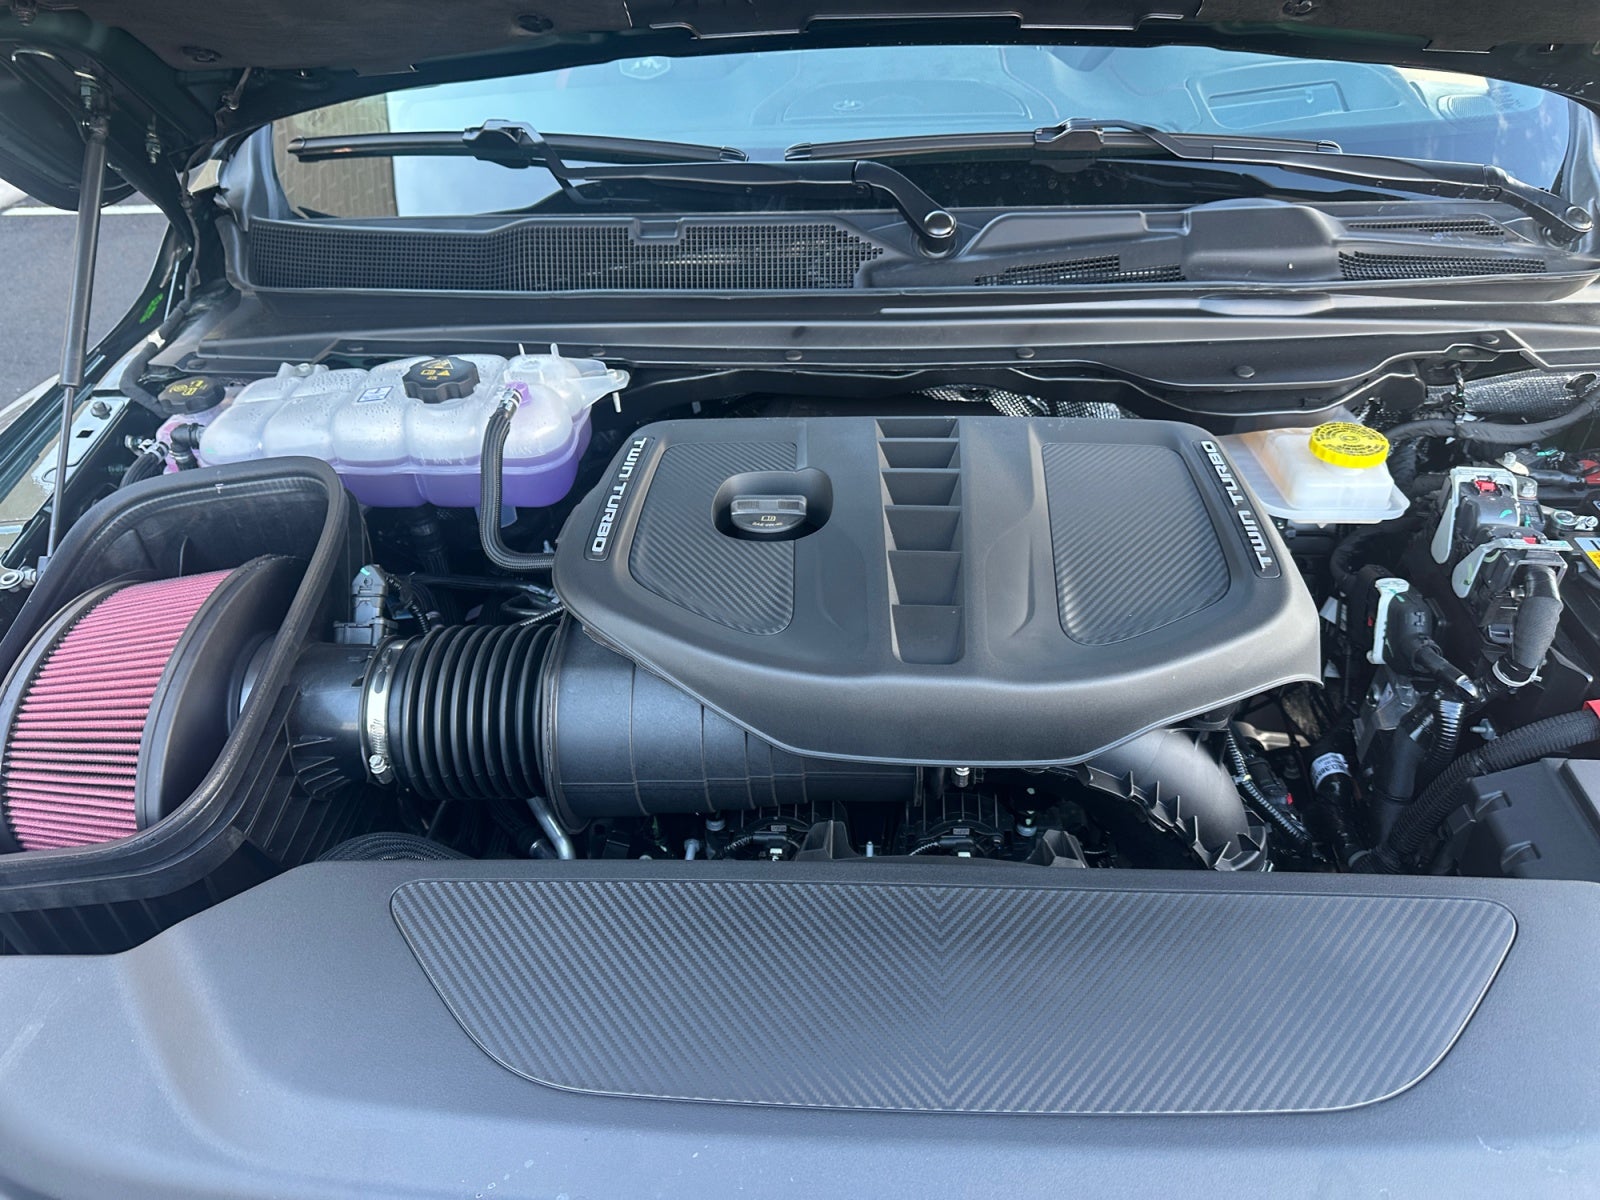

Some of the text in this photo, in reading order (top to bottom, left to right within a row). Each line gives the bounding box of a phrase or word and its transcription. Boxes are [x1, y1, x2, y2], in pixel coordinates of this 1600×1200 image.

[591, 437, 647, 552] TWIN TURBO
[1200, 440, 1273, 570] TWIN TURBO
